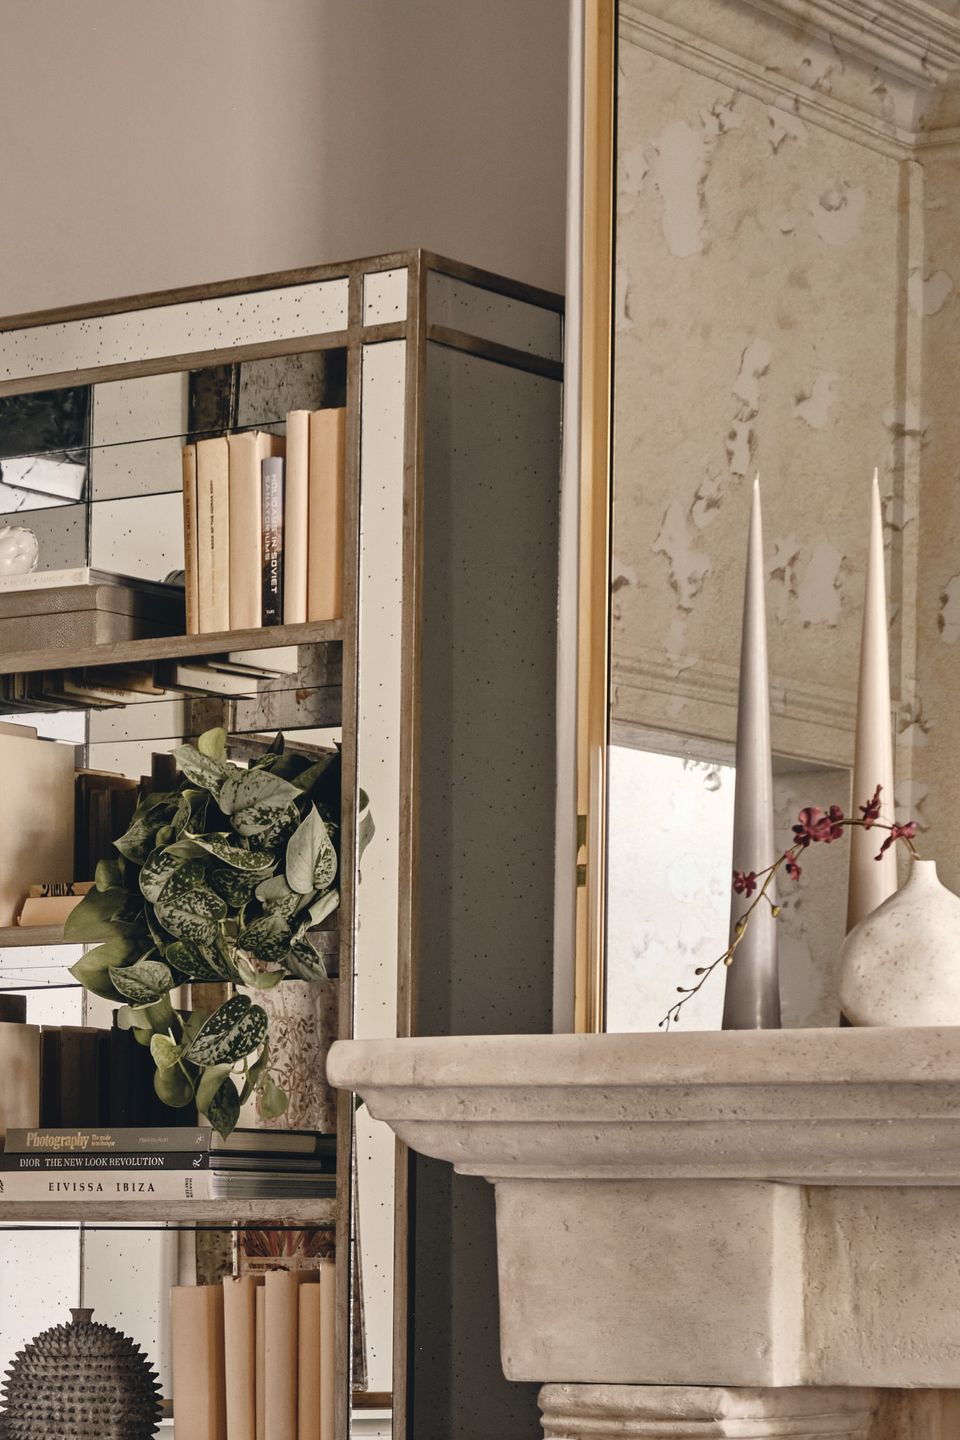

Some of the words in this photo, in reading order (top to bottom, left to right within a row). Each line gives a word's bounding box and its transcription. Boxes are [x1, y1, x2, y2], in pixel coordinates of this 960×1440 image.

[270, 536, 278, 548] IN
[270, 552, 278, 595] SOVIET
[26, 1132, 89, 1150] Photography
[19, 1158, 40, 1167] DIOR
[45, 1158, 63, 1167] THE
[63, 1158, 83, 1167] NEW
[84, 1157, 108, 1167] LOOK
[109, 1157, 165, 1167] REVOLUTION
[48, 1182, 104, 1192] EIVISSA
[116, 1182, 155, 1192] IBIZA
